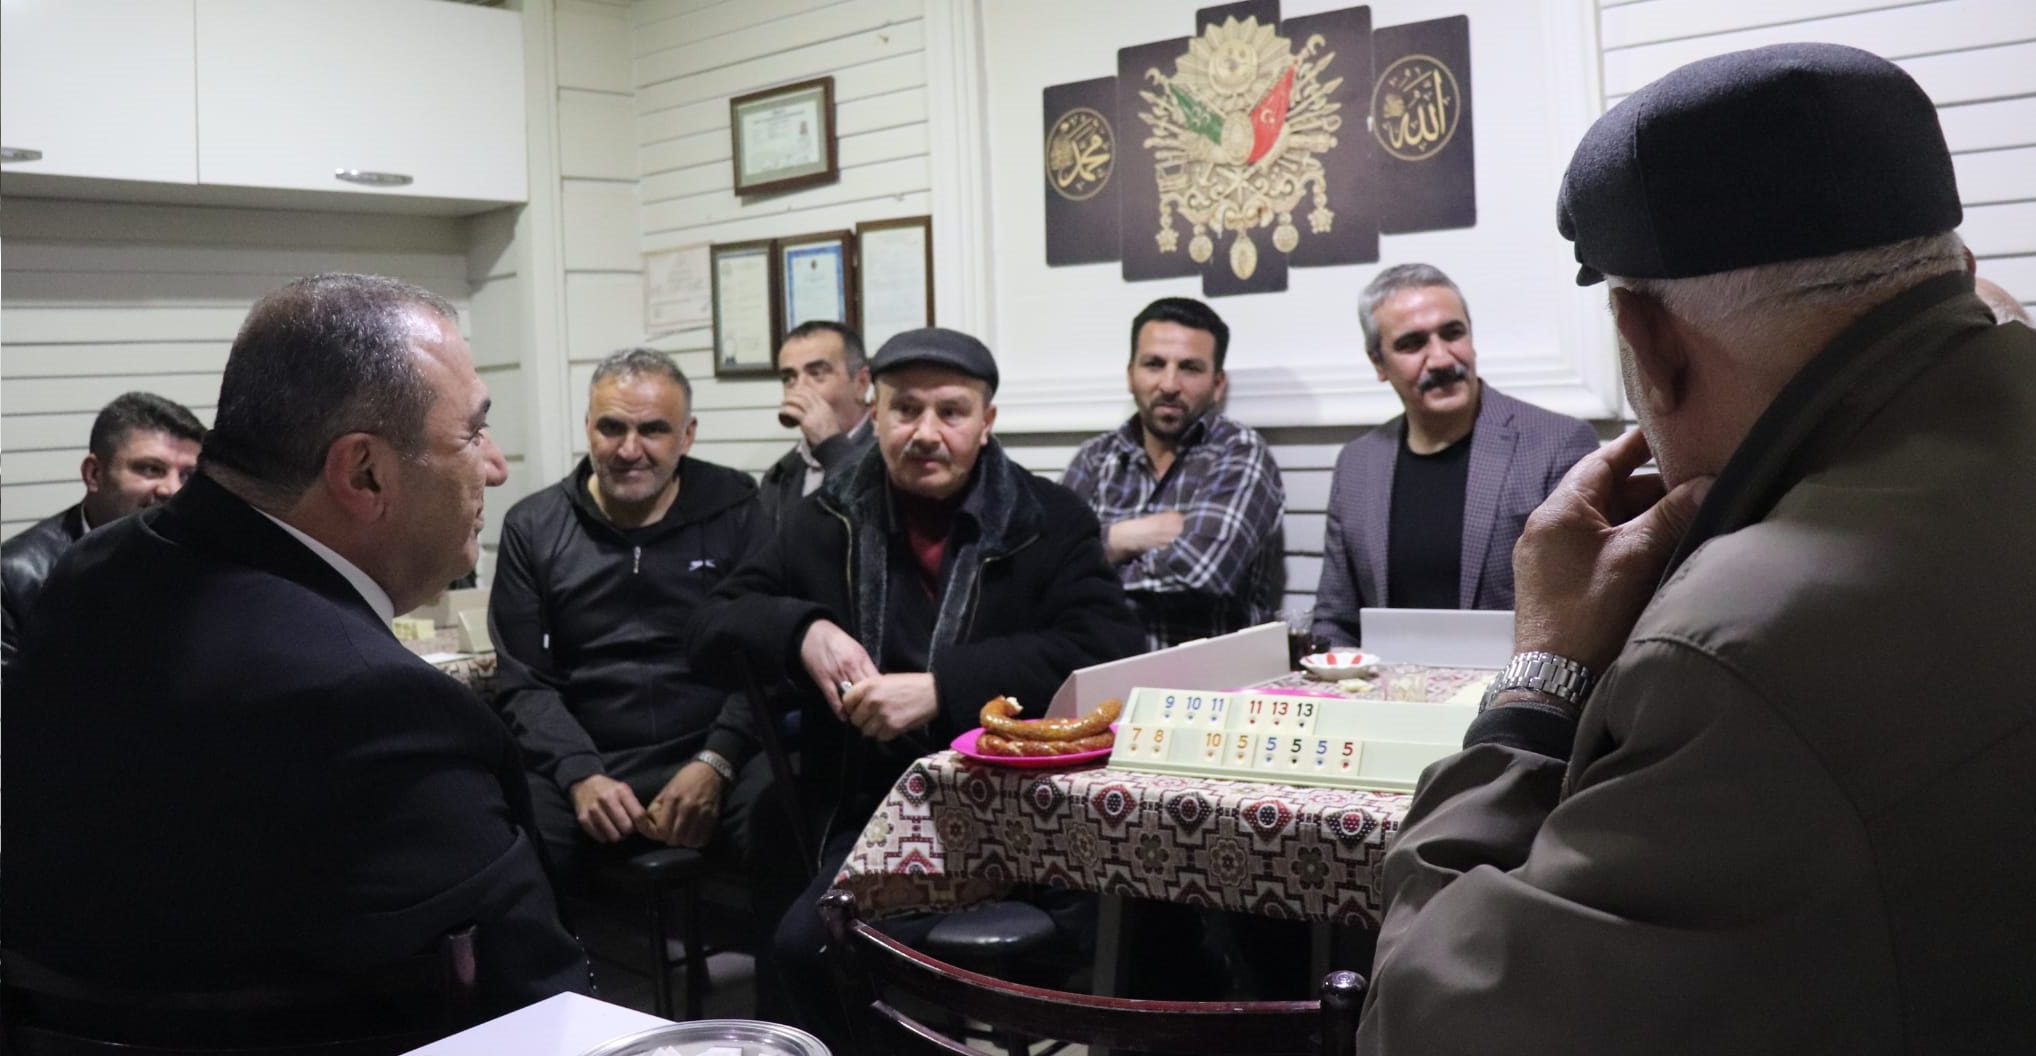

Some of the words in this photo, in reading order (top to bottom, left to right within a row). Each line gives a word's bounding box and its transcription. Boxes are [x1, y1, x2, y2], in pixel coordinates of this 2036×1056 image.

[1165, 695, 1175, 708] 9
[1186, 697, 1202, 710] 10
[1212, 698, 1224, 712] 11
[1250, 700, 1263, 714] 11
[1272, 702, 1288, 716] 13
[1297, 703, 1314, 717] 13
[1132, 728, 1142, 741] 7
[1154, 729, 1164, 743] 8
[1206, 732, 1221, 747] 10
[1237, 735, 1248, 749] 5
[1266, 737, 1277, 751] 5
[1291, 738, 1302, 753] 5
[1316, 740, 1327, 754] 5
[1342, 742, 1353, 756] 5
